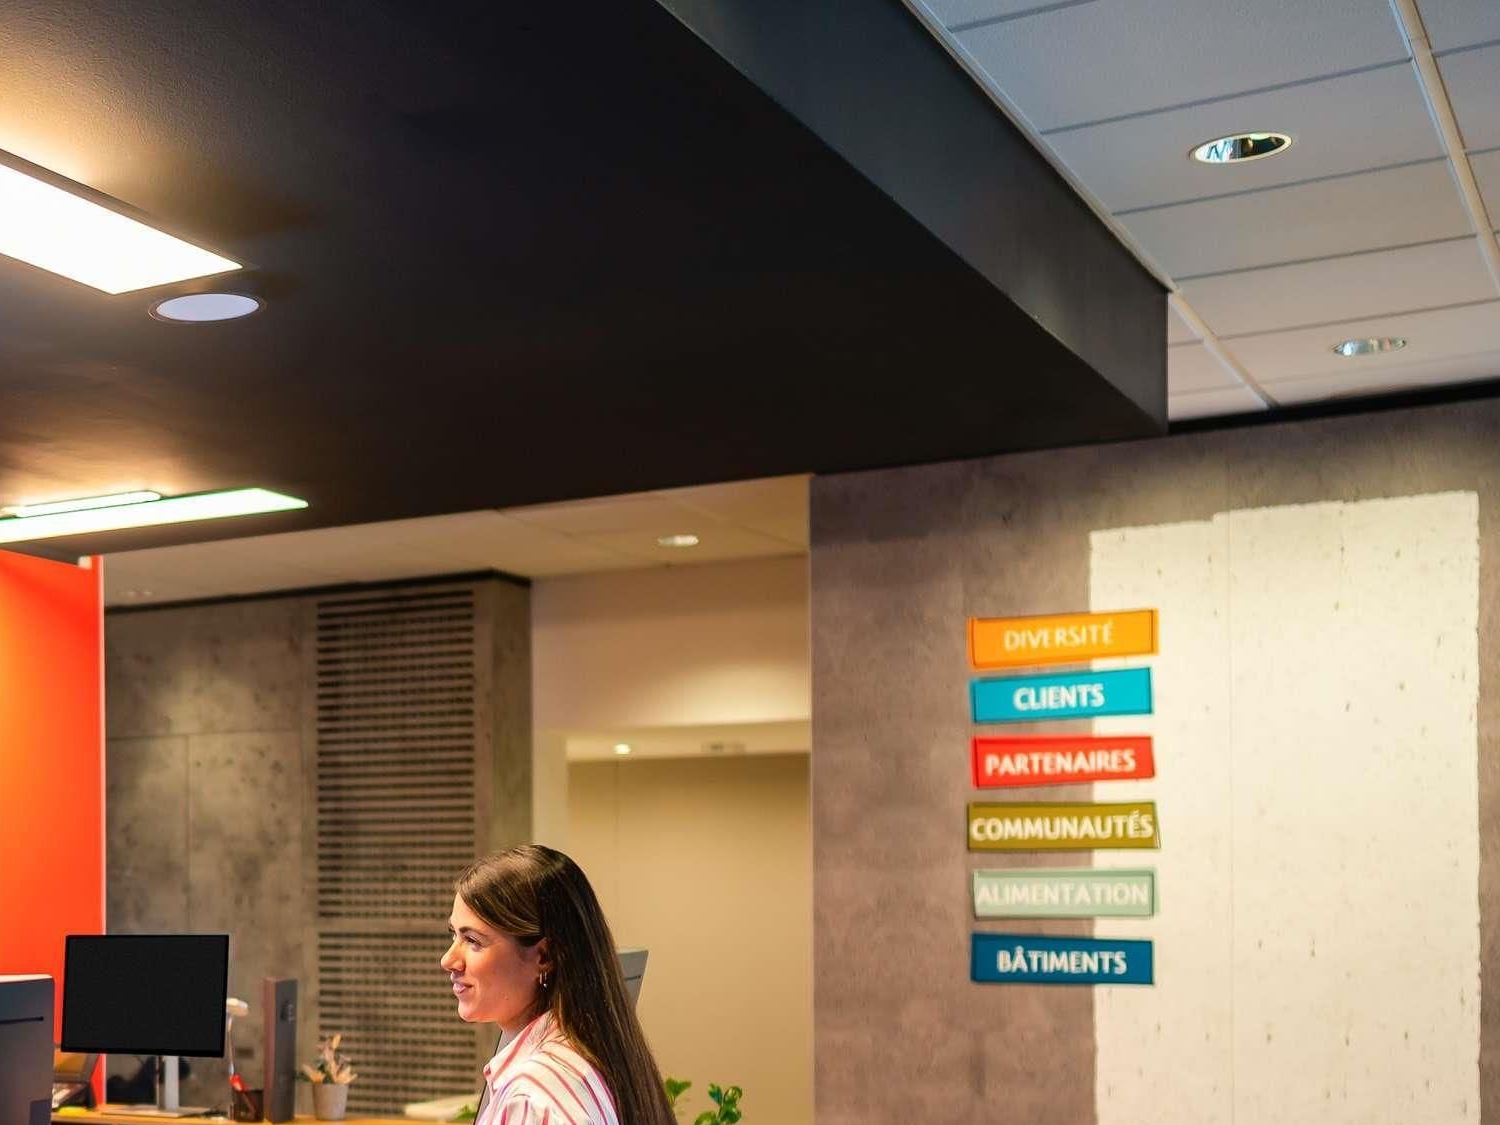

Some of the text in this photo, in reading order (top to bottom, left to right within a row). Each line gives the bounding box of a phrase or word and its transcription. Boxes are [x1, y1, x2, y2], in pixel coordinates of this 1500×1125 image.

[1003, 620, 1115, 652] DIVERSITÉ
[1012, 682, 1106, 711] CLIENTS
[984, 748, 1137, 777] PARTENAIRES
[971, 810, 1155, 842] COMMUNAUTÉS
[975, 881, 1150, 907] ALIMENTATION
[996, 945, 1128, 975] BÂTIMENTS
